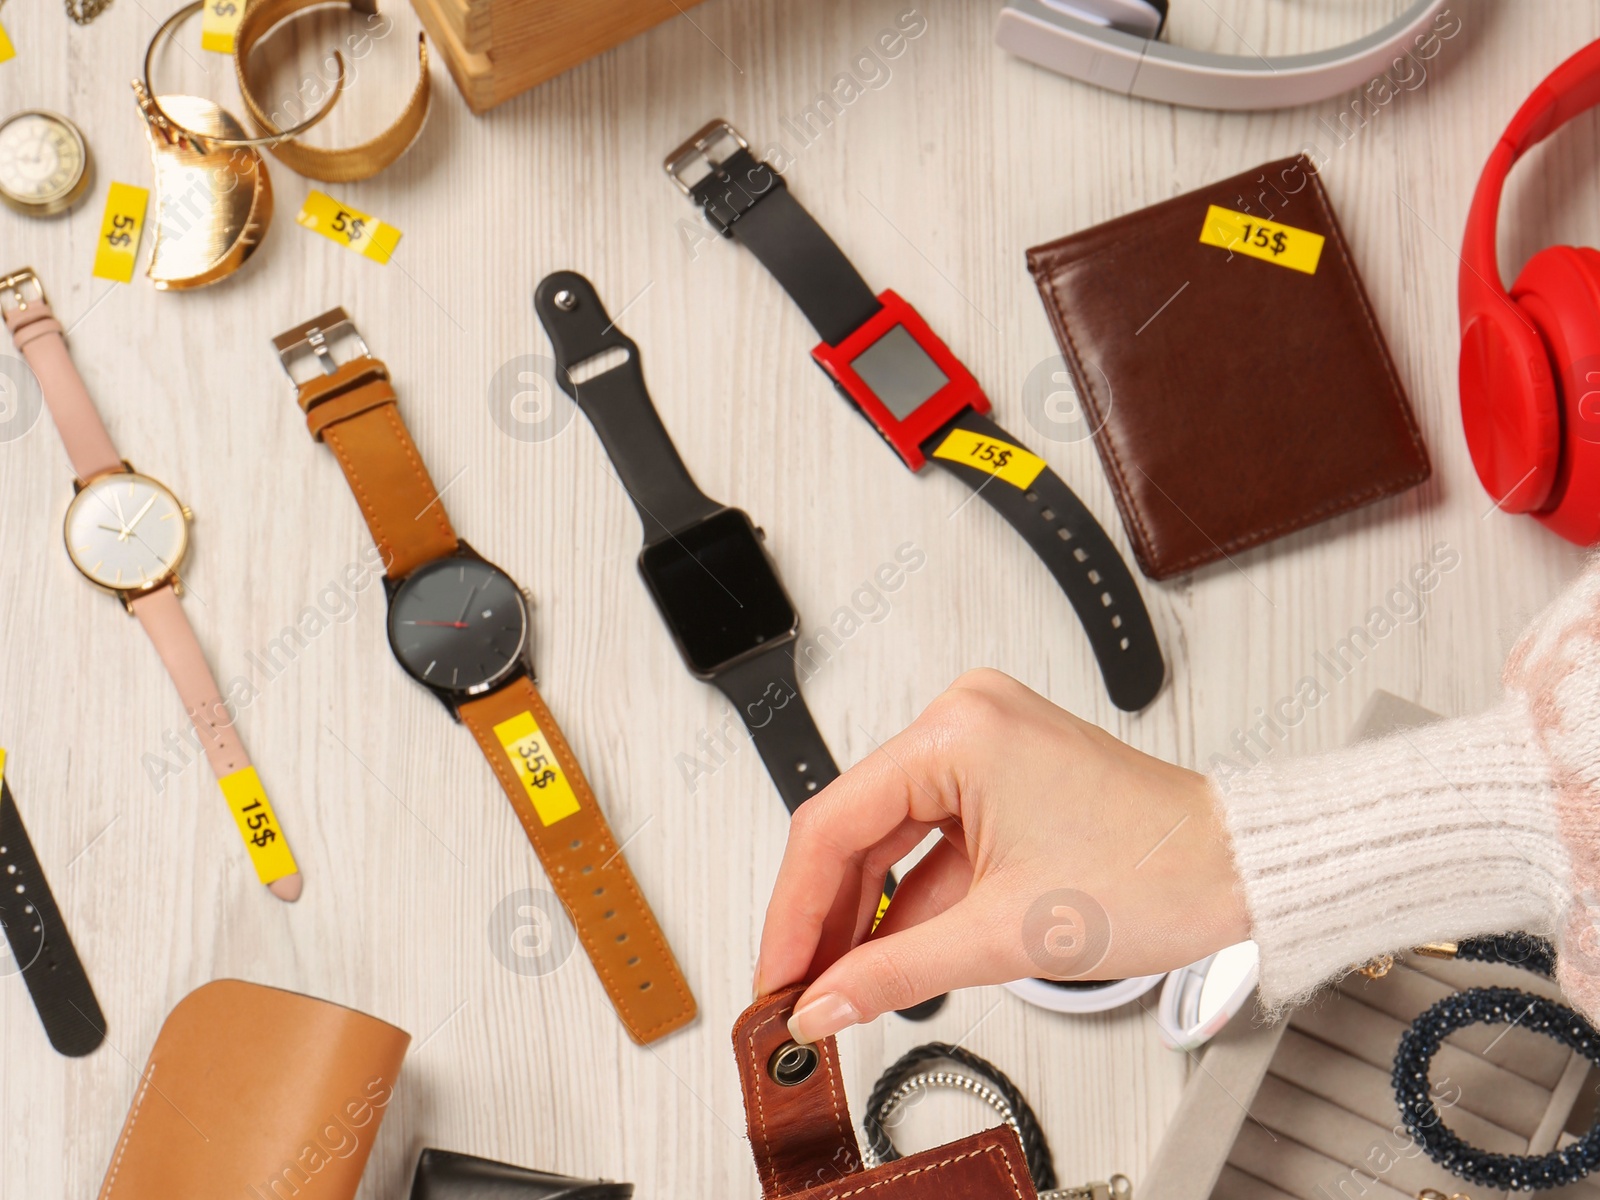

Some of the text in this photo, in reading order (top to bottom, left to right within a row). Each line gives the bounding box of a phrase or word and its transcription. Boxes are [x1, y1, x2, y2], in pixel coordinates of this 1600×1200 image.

[105, 214, 134, 247] 5$
[331, 210, 365, 241] 5$
[1242, 224, 1288, 257] 15$
[970, 441, 1014, 469] 15$
[518, 740, 556, 789] 35$
[241, 799, 276, 848] 15$
